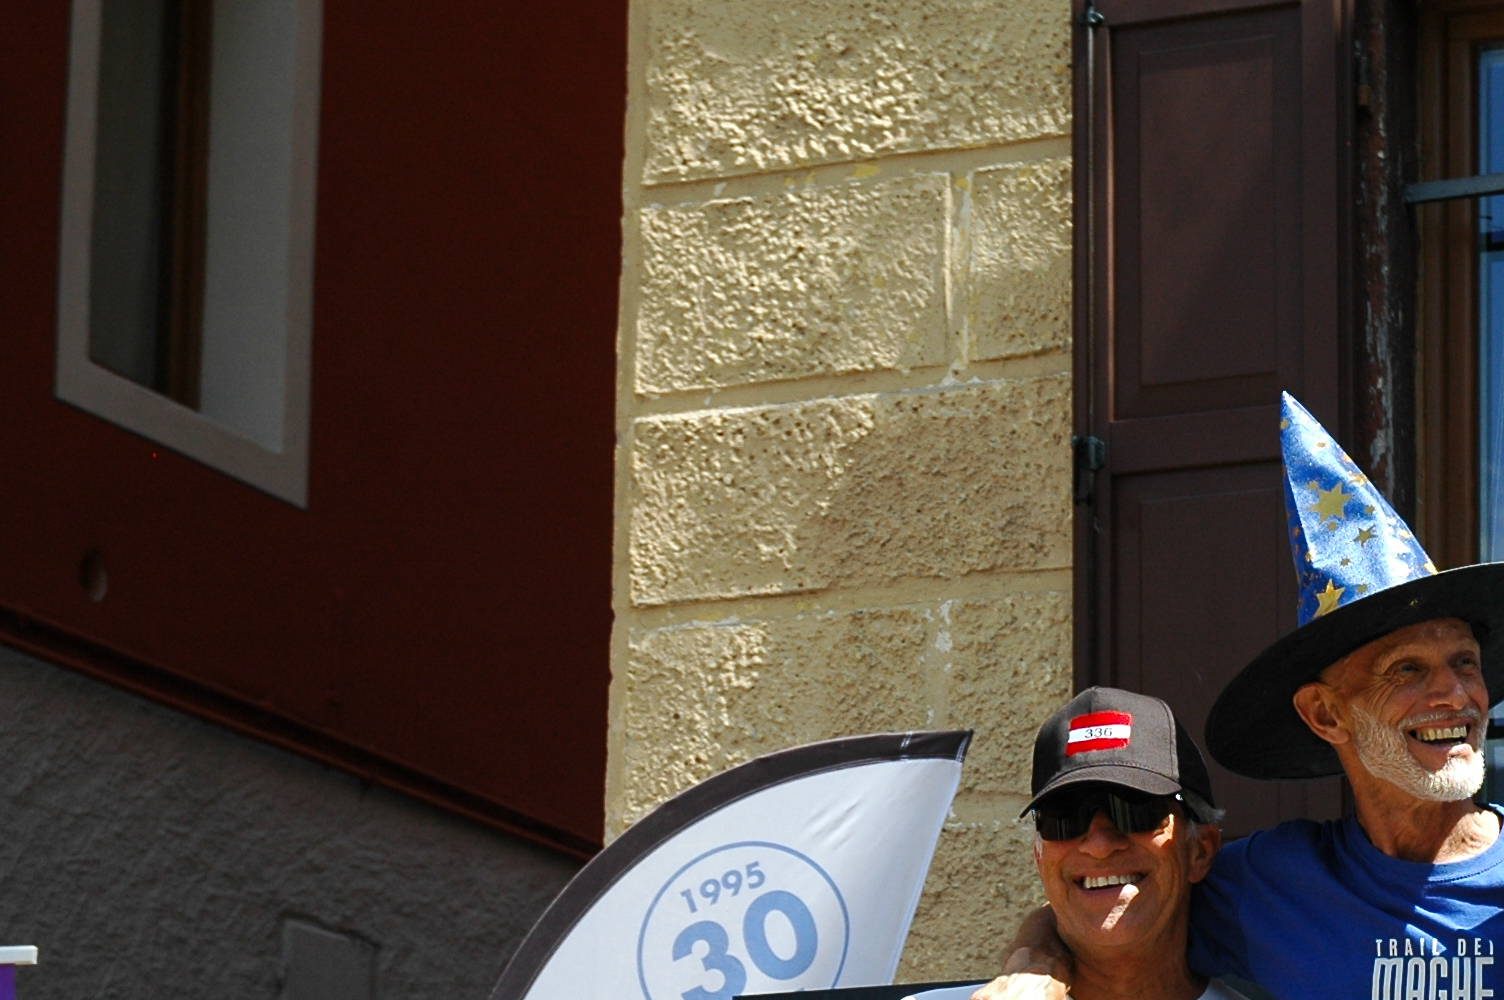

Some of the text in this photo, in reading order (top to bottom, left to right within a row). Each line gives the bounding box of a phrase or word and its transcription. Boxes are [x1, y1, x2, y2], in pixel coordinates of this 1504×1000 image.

[1084, 727, 1113, 739] 336
[680, 861, 767, 914] 1995
[1376, 938, 1440, 957] TRAIL
